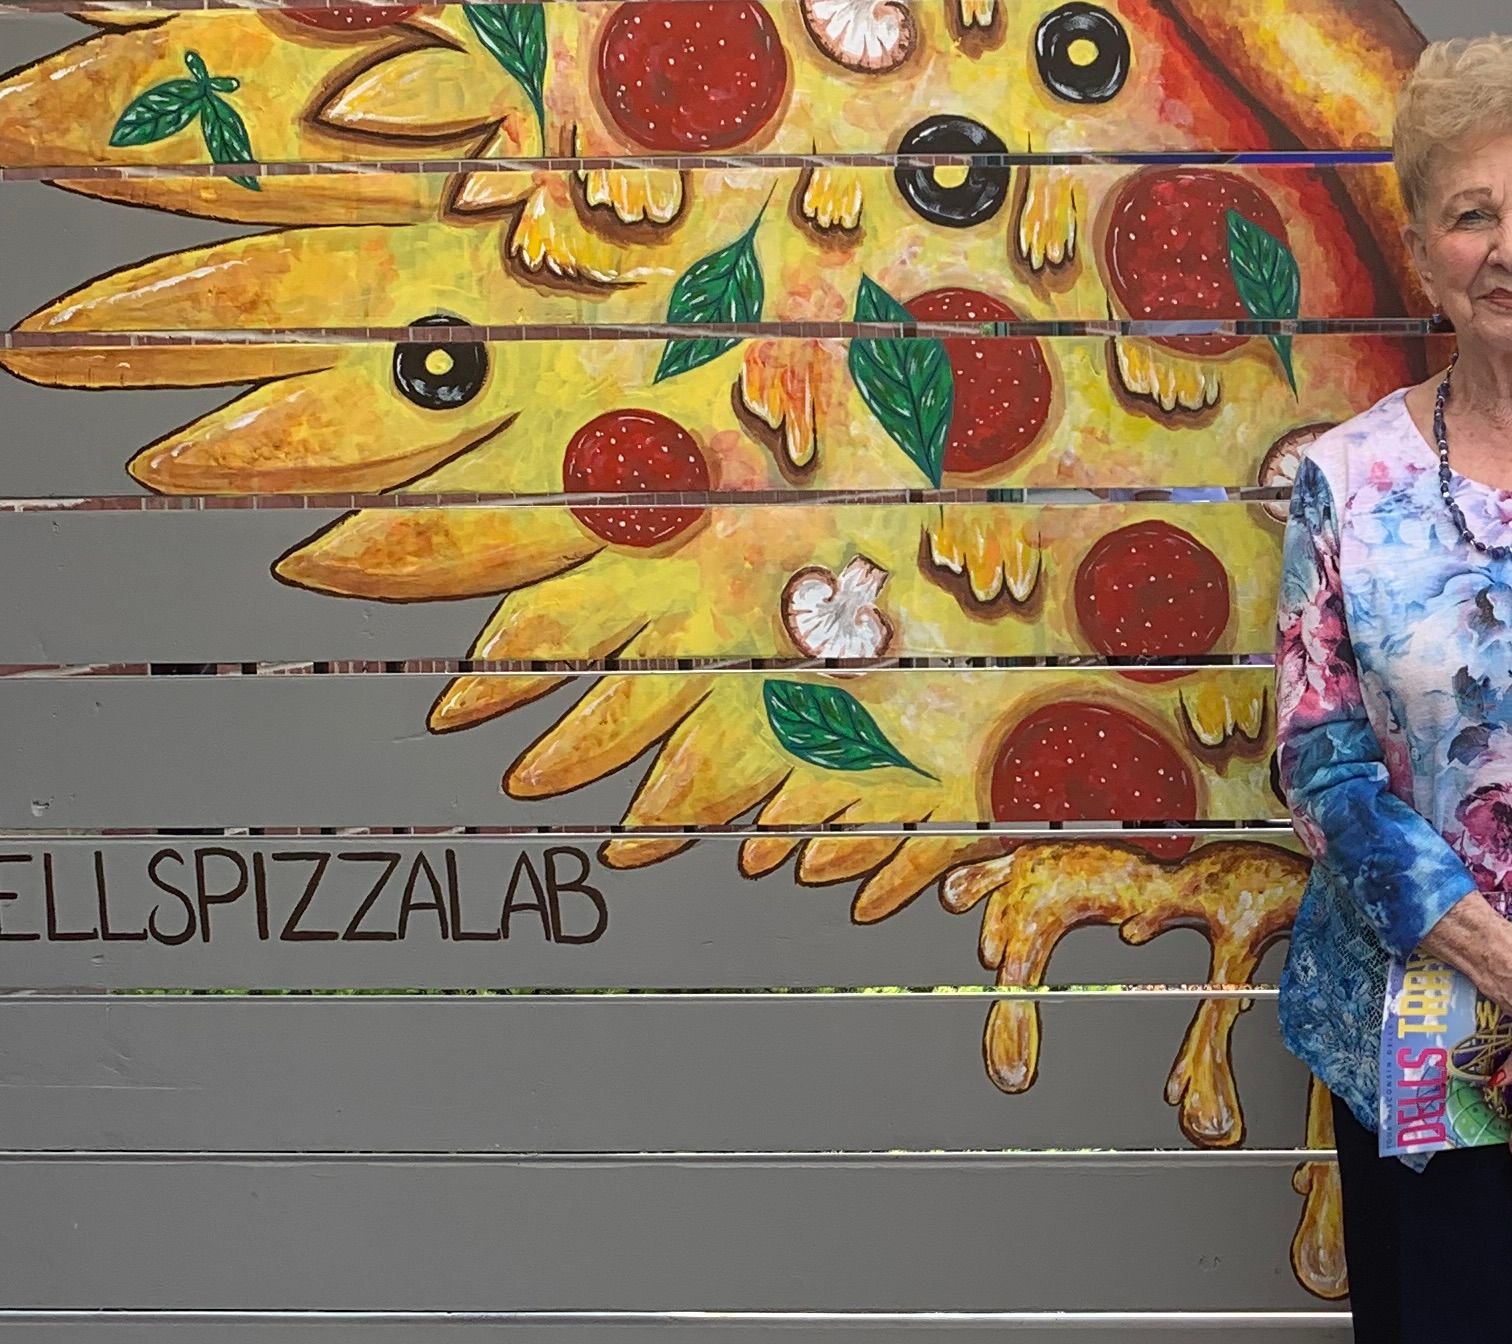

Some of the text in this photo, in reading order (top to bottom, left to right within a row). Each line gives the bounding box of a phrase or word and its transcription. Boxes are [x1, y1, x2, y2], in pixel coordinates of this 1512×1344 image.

[0, 846, 609, 946] ELLSPIZZALAB
[1396, 945, 1453, 1148] DELLS TRAV
